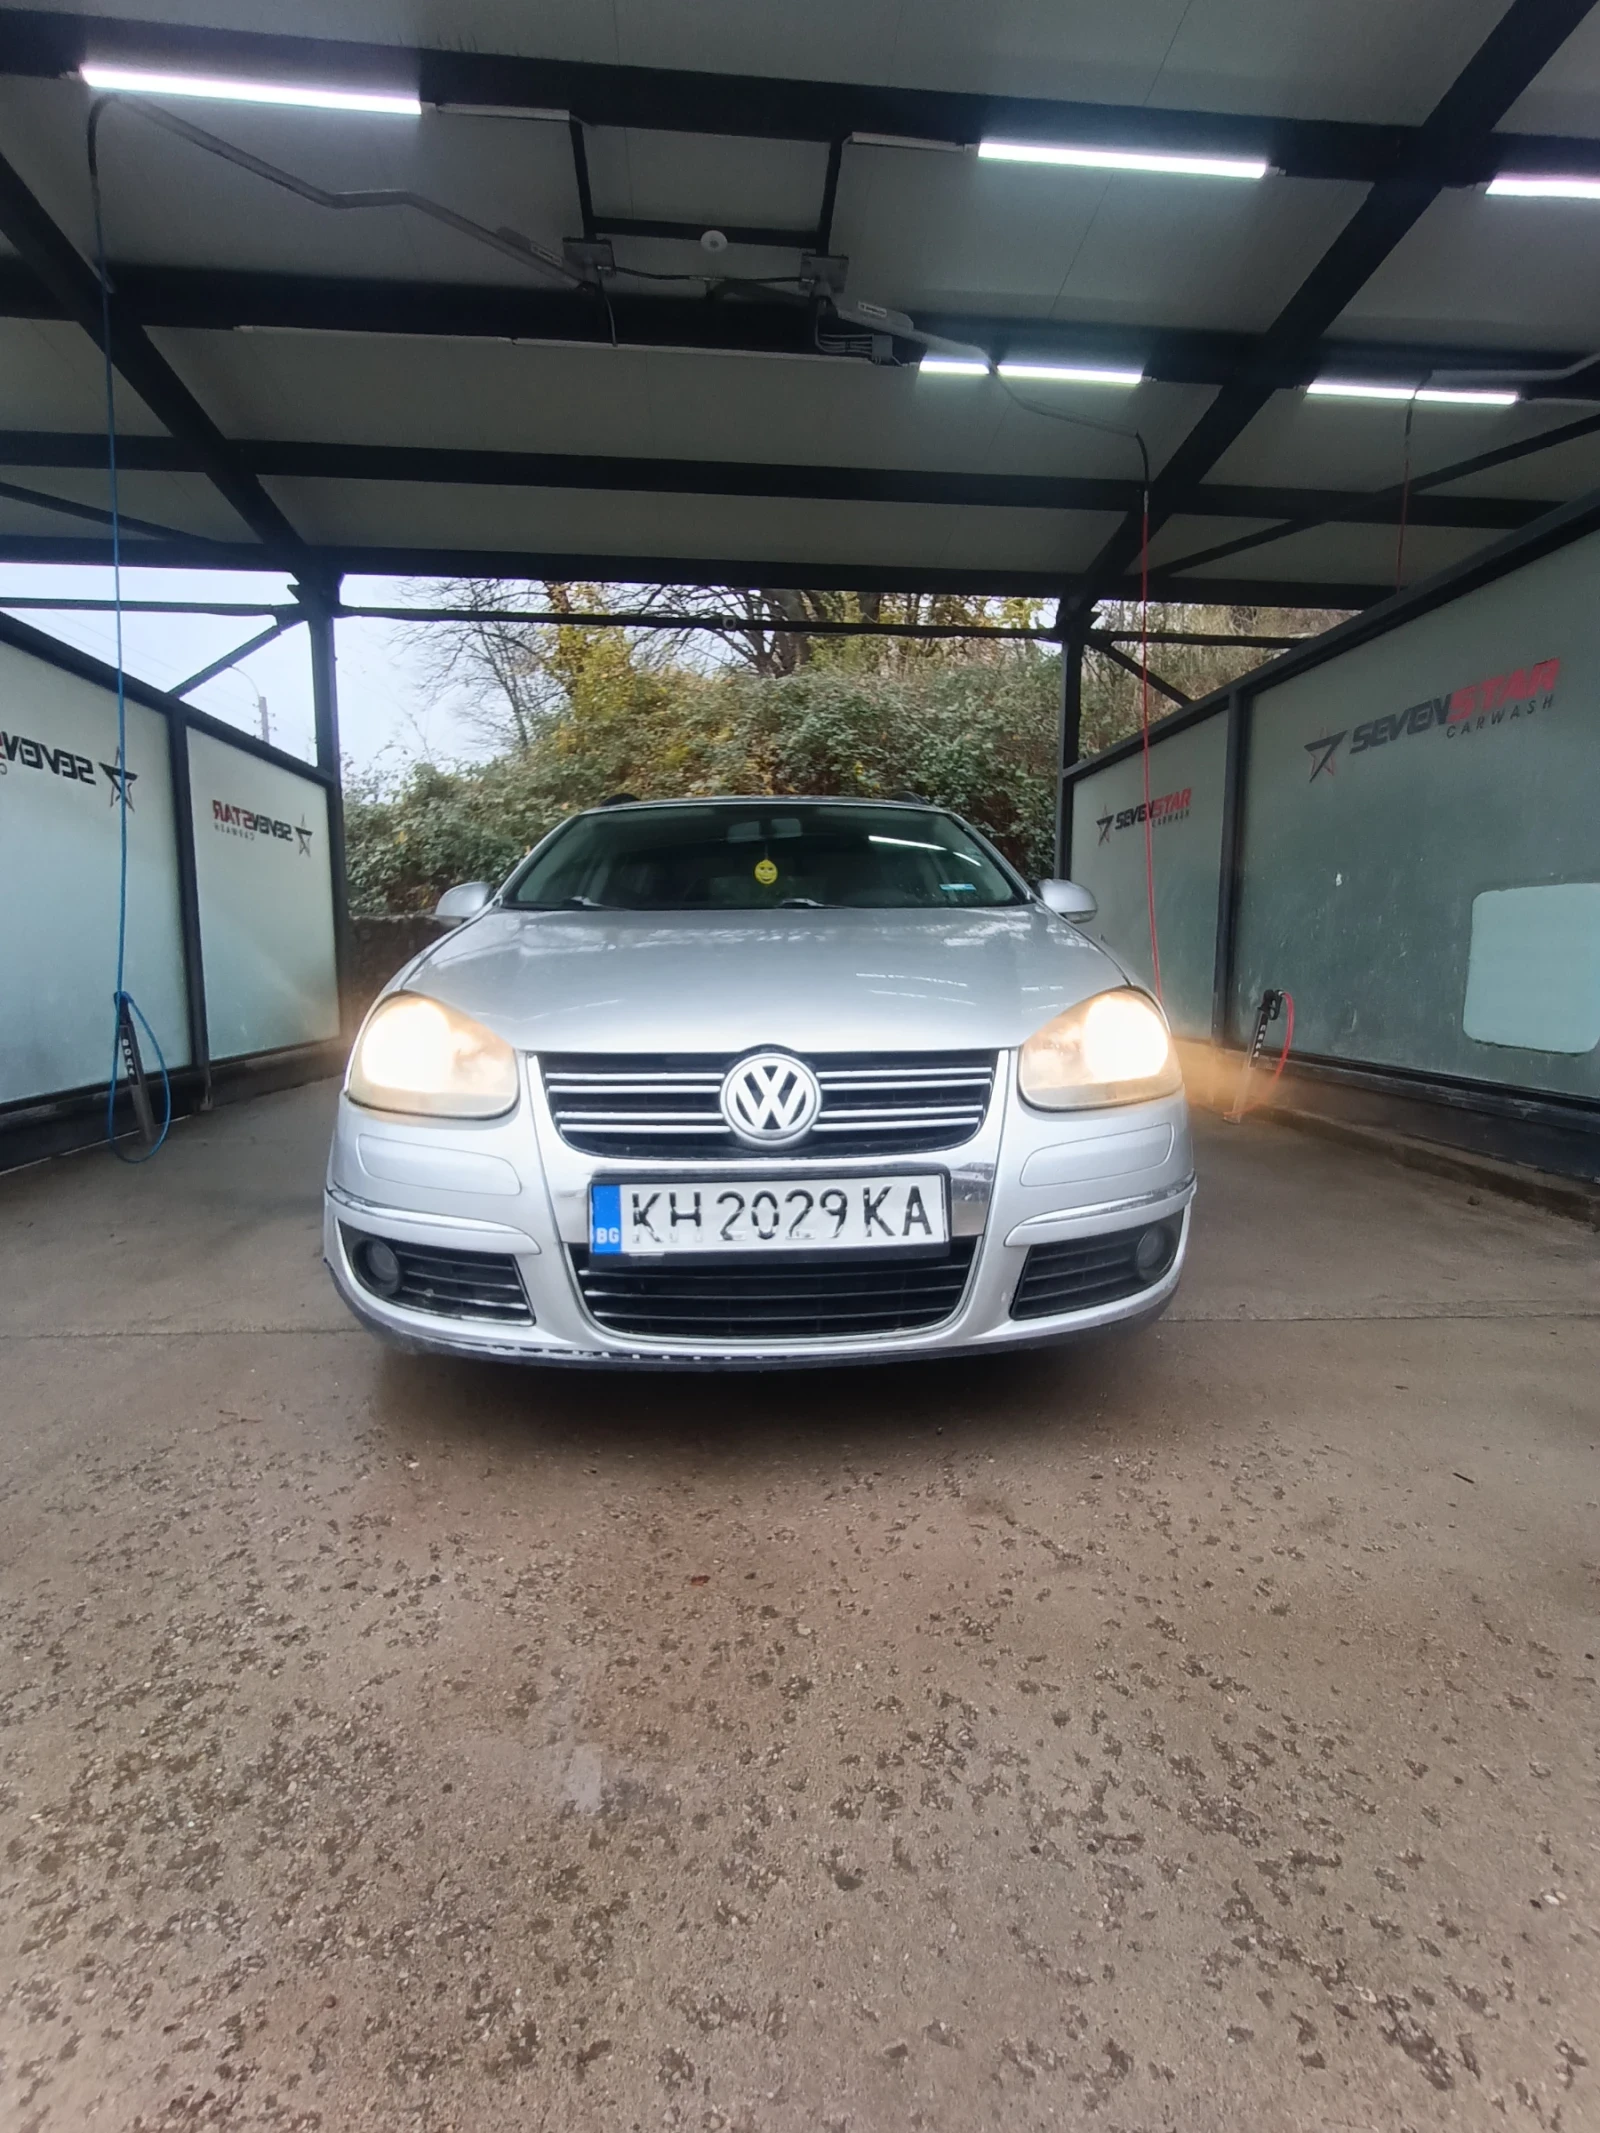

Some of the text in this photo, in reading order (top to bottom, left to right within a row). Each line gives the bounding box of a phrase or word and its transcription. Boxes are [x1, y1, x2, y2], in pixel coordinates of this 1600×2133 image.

[1446, 694, 1554, 739] CARWASH
[596, 1227, 620, 1244] BG
[716, 1188, 848, 1241] 2029
